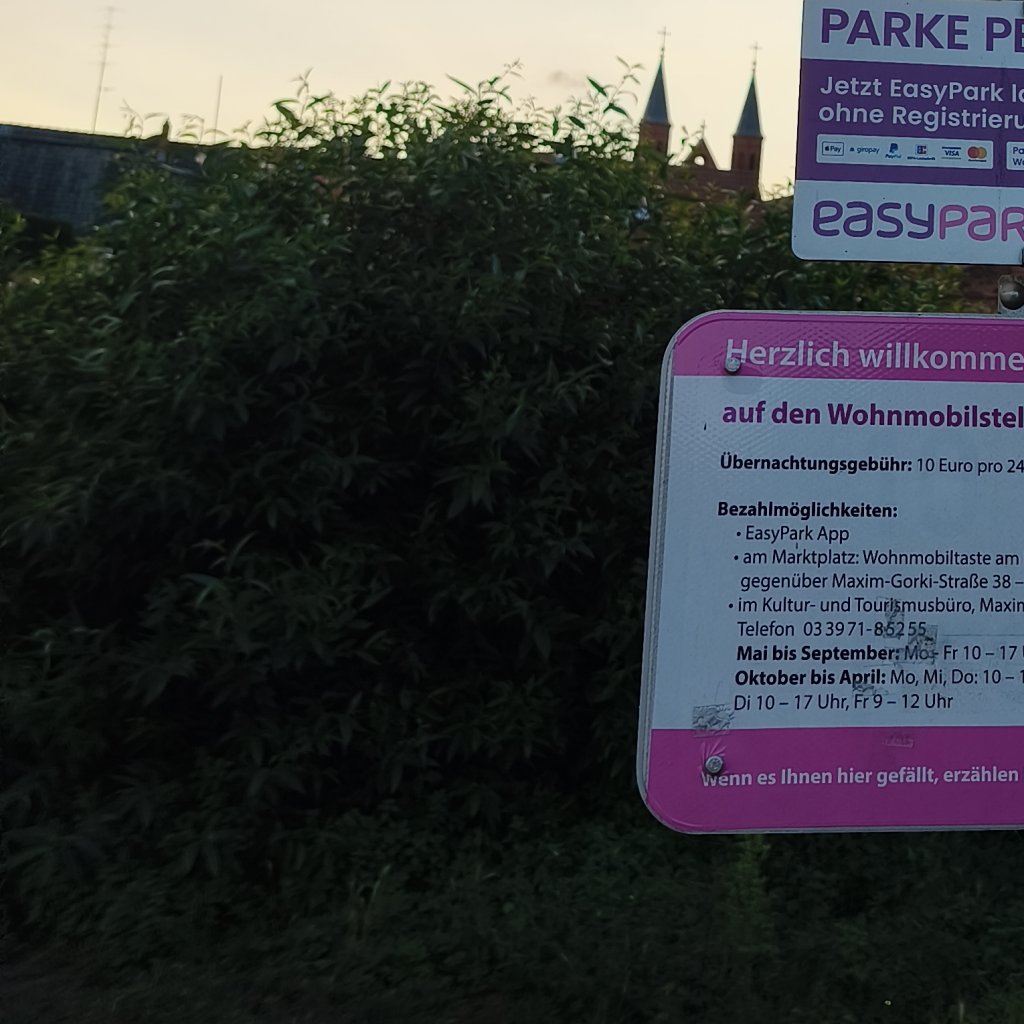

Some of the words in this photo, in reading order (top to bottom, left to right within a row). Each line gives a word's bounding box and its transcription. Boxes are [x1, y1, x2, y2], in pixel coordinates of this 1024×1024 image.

[821, 7, 970, 51] PARKE
[820, 77, 882, 98] Jetzt
[889, 79, 1003, 105] EasyPark
[818, 104, 884, 126] ohne
[857, 146, 880, 154] giropay
[726, 338, 850, 368] Herzlich
[722, 401, 766, 424] auf
[771, 402, 821, 425] den
[720, 452, 913, 474] Übernachtungsgebühr:
[917, 457, 935, 472] 10
[939, 458, 974, 473] Euro
[977, 461, 1003, 476] pro
[1007, 459, 1024, 473] 24
[718, 501, 898, 519] Bezahlmöglichkeiten:
[746, 526, 813, 543] EasyPark
[817, 527, 849, 543] App
[743, 553, 767, 565] am
[772, 550, 859, 568] Marktplatz:
[863, 550, 991, 566] Wohnmobiltaste
[996, 554, 1019, 566] am
[741, 574, 828, 592] gegenüber
[832, 573, 988, 590] Maxim-Gorki-Straße
[992, 575, 1011, 589] 38
[738, 598, 757, 612] im
[762, 597, 815, 613] Kultur-
[820, 597, 850, 613] und
[854, 597, 975, 615] Tourismusbüro,
[738, 621, 795, 637] Telefon
[737, 646, 767, 661] Mai
[772, 646, 797, 661] bis
[801, 645, 900, 664] September:
[904, 645, 930, 661] Mo
[943, 645, 958, 661] Fr
[963, 646, 982, 660] 10
[1000, 646, 1018, 660] 17
[735, 669, 806, 686] Oktober
[810, 669, 835, 685] bis
[839, 669, 886, 689] April:
[890, 670, 919, 687] Mo,
[923, 669, 947, 687] Mi,
[951, 670, 978, 685] Do:
[982, 670, 1001, 684] 10
[734, 695, 751, 711] Di
[756, 695, 775, 710] 10
[794, 694, 812, 709] 17
[817, 693, 849, 712] Uhr,
[854, 694, 870, 709] Fr
[874, 694, 883, 709] 9
[902, 694, 920, 709] 12
[925, 693, 953, 709] Uhr
[757, 773, 776, 785] es
[781, 768, 833, 785] Ihnen
[837, 767, 872, 784] hier
[877, 767, 939, 788] gefällt,
[943, 767, 1019, 784] erzählen
